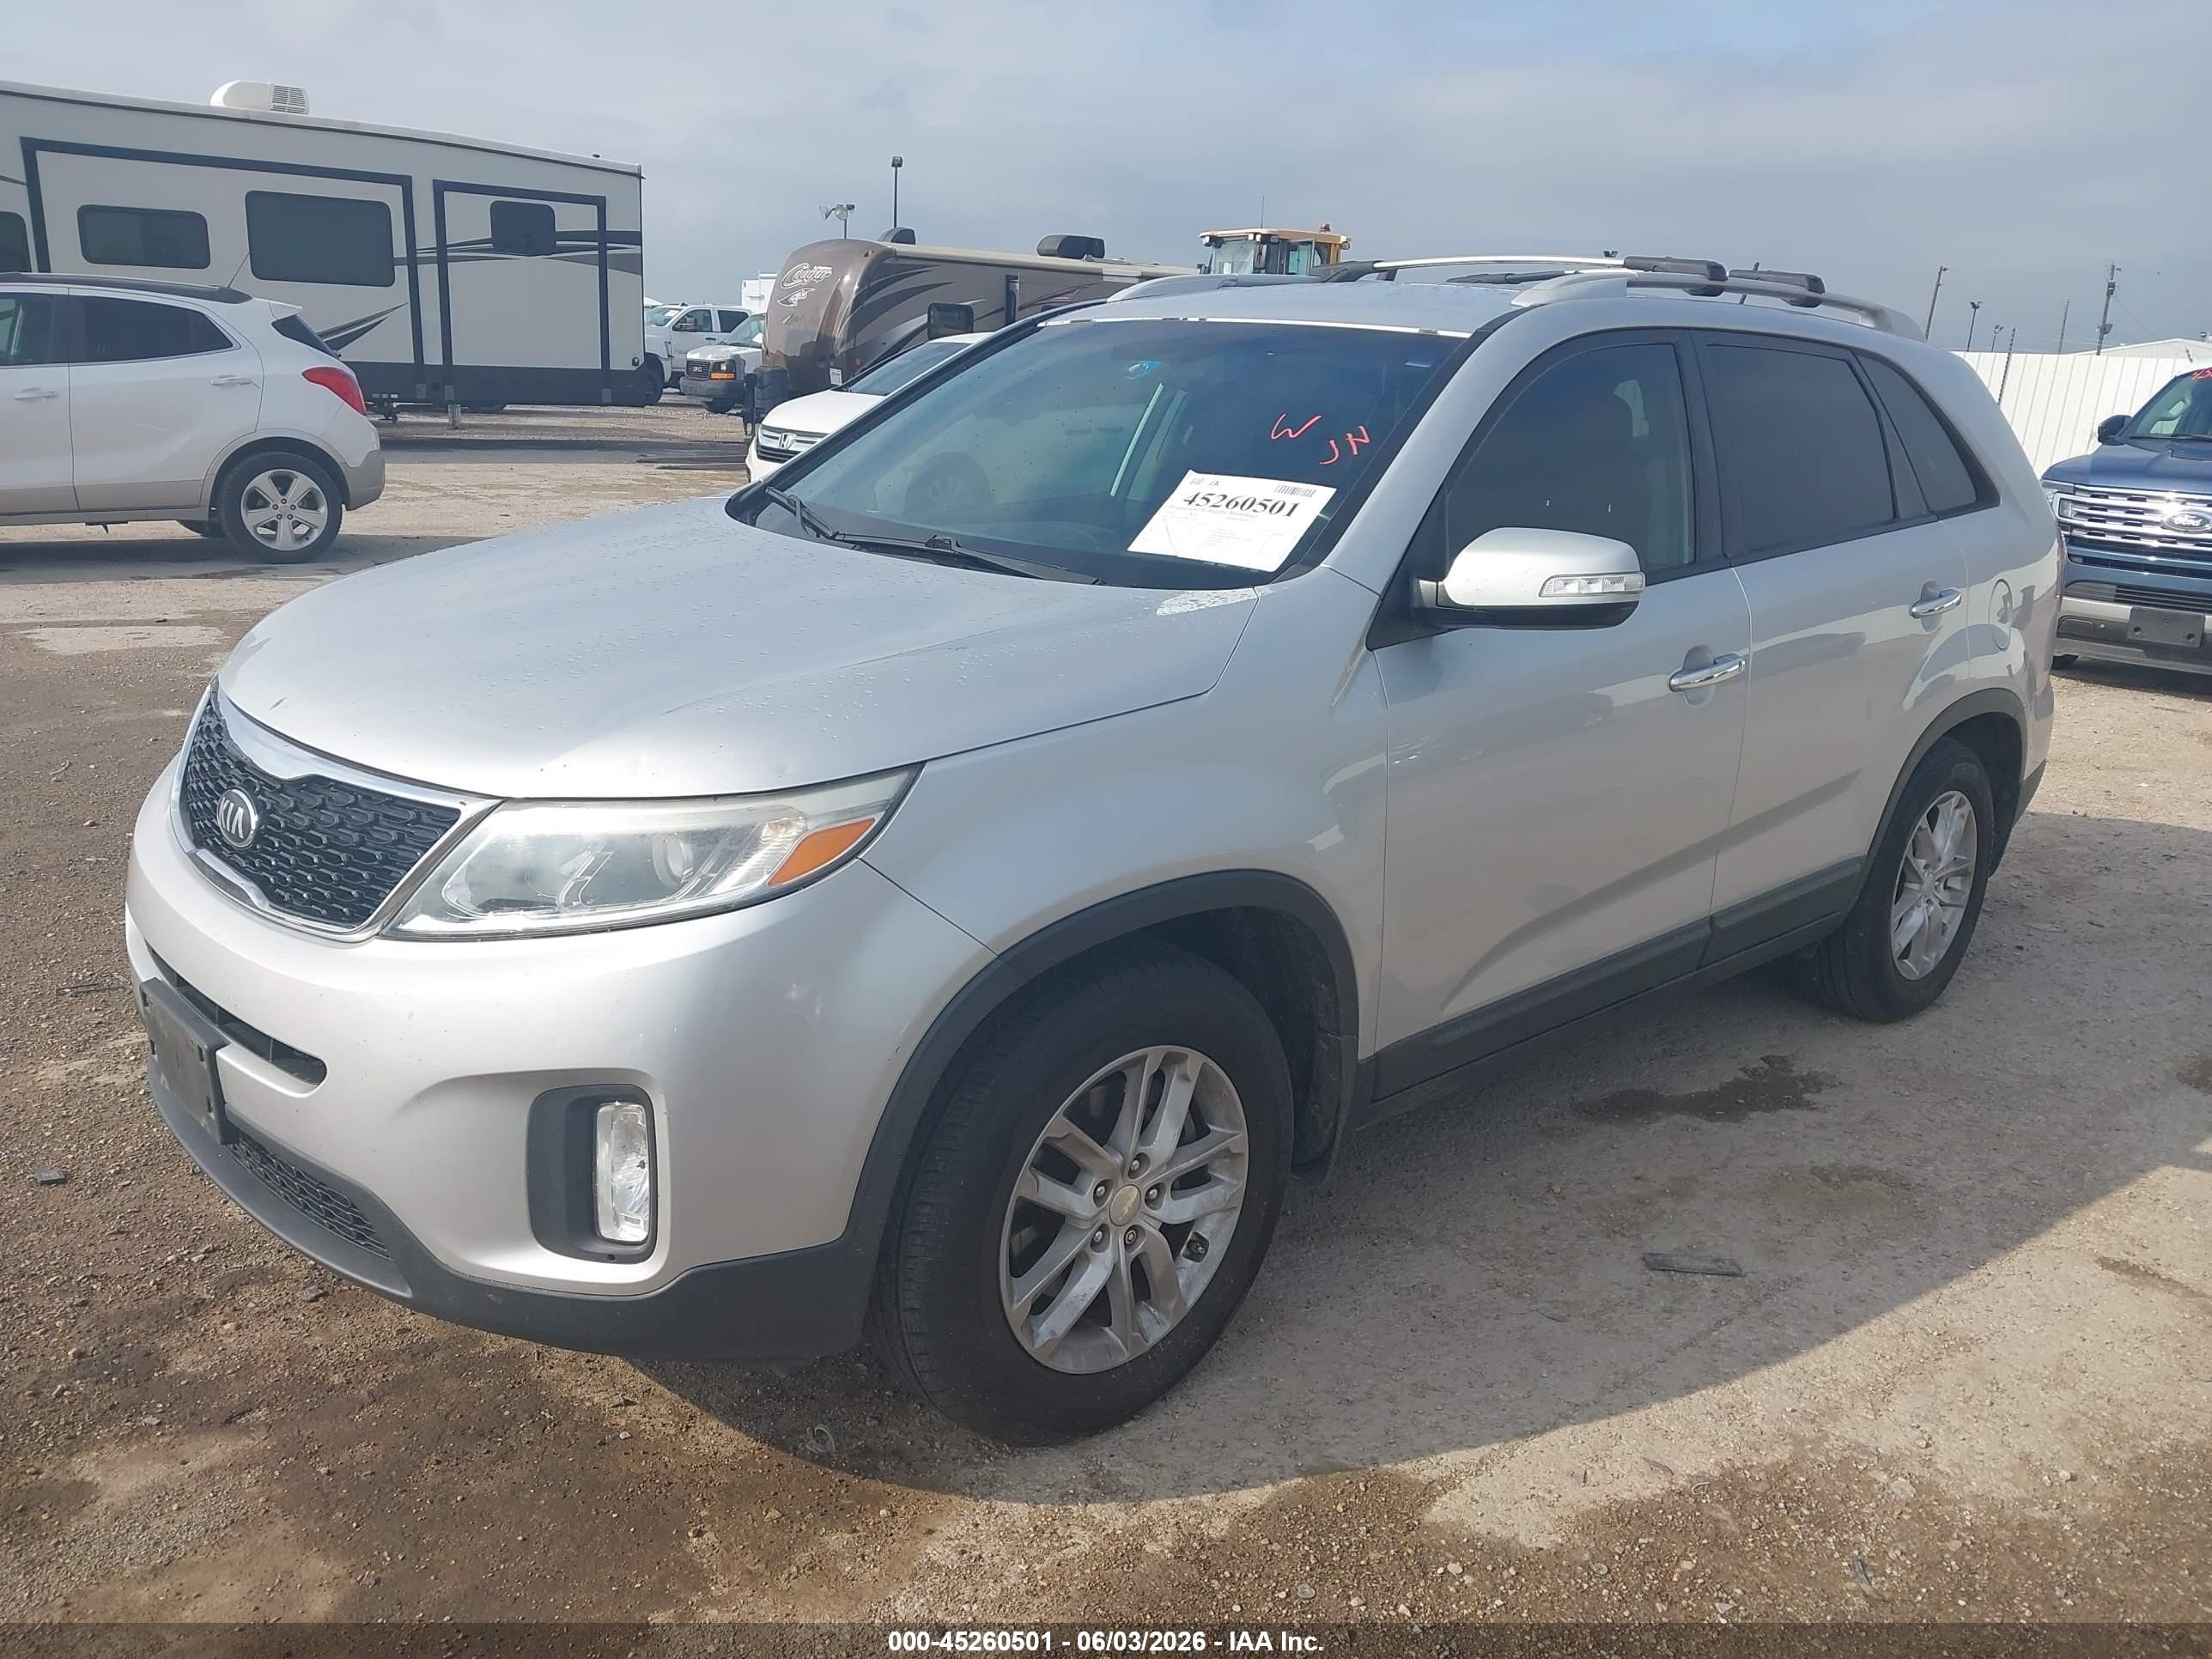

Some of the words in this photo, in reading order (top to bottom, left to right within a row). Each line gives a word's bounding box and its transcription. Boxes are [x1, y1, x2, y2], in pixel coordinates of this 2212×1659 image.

[781, 262, 832, 289] Cougar
[1270, 413, 1322, 441] W
[1183, 490, 1300, 518] 45260501
[2173, 514, 2203, 526] Ford
[218, 797, 244, 839] KIA
